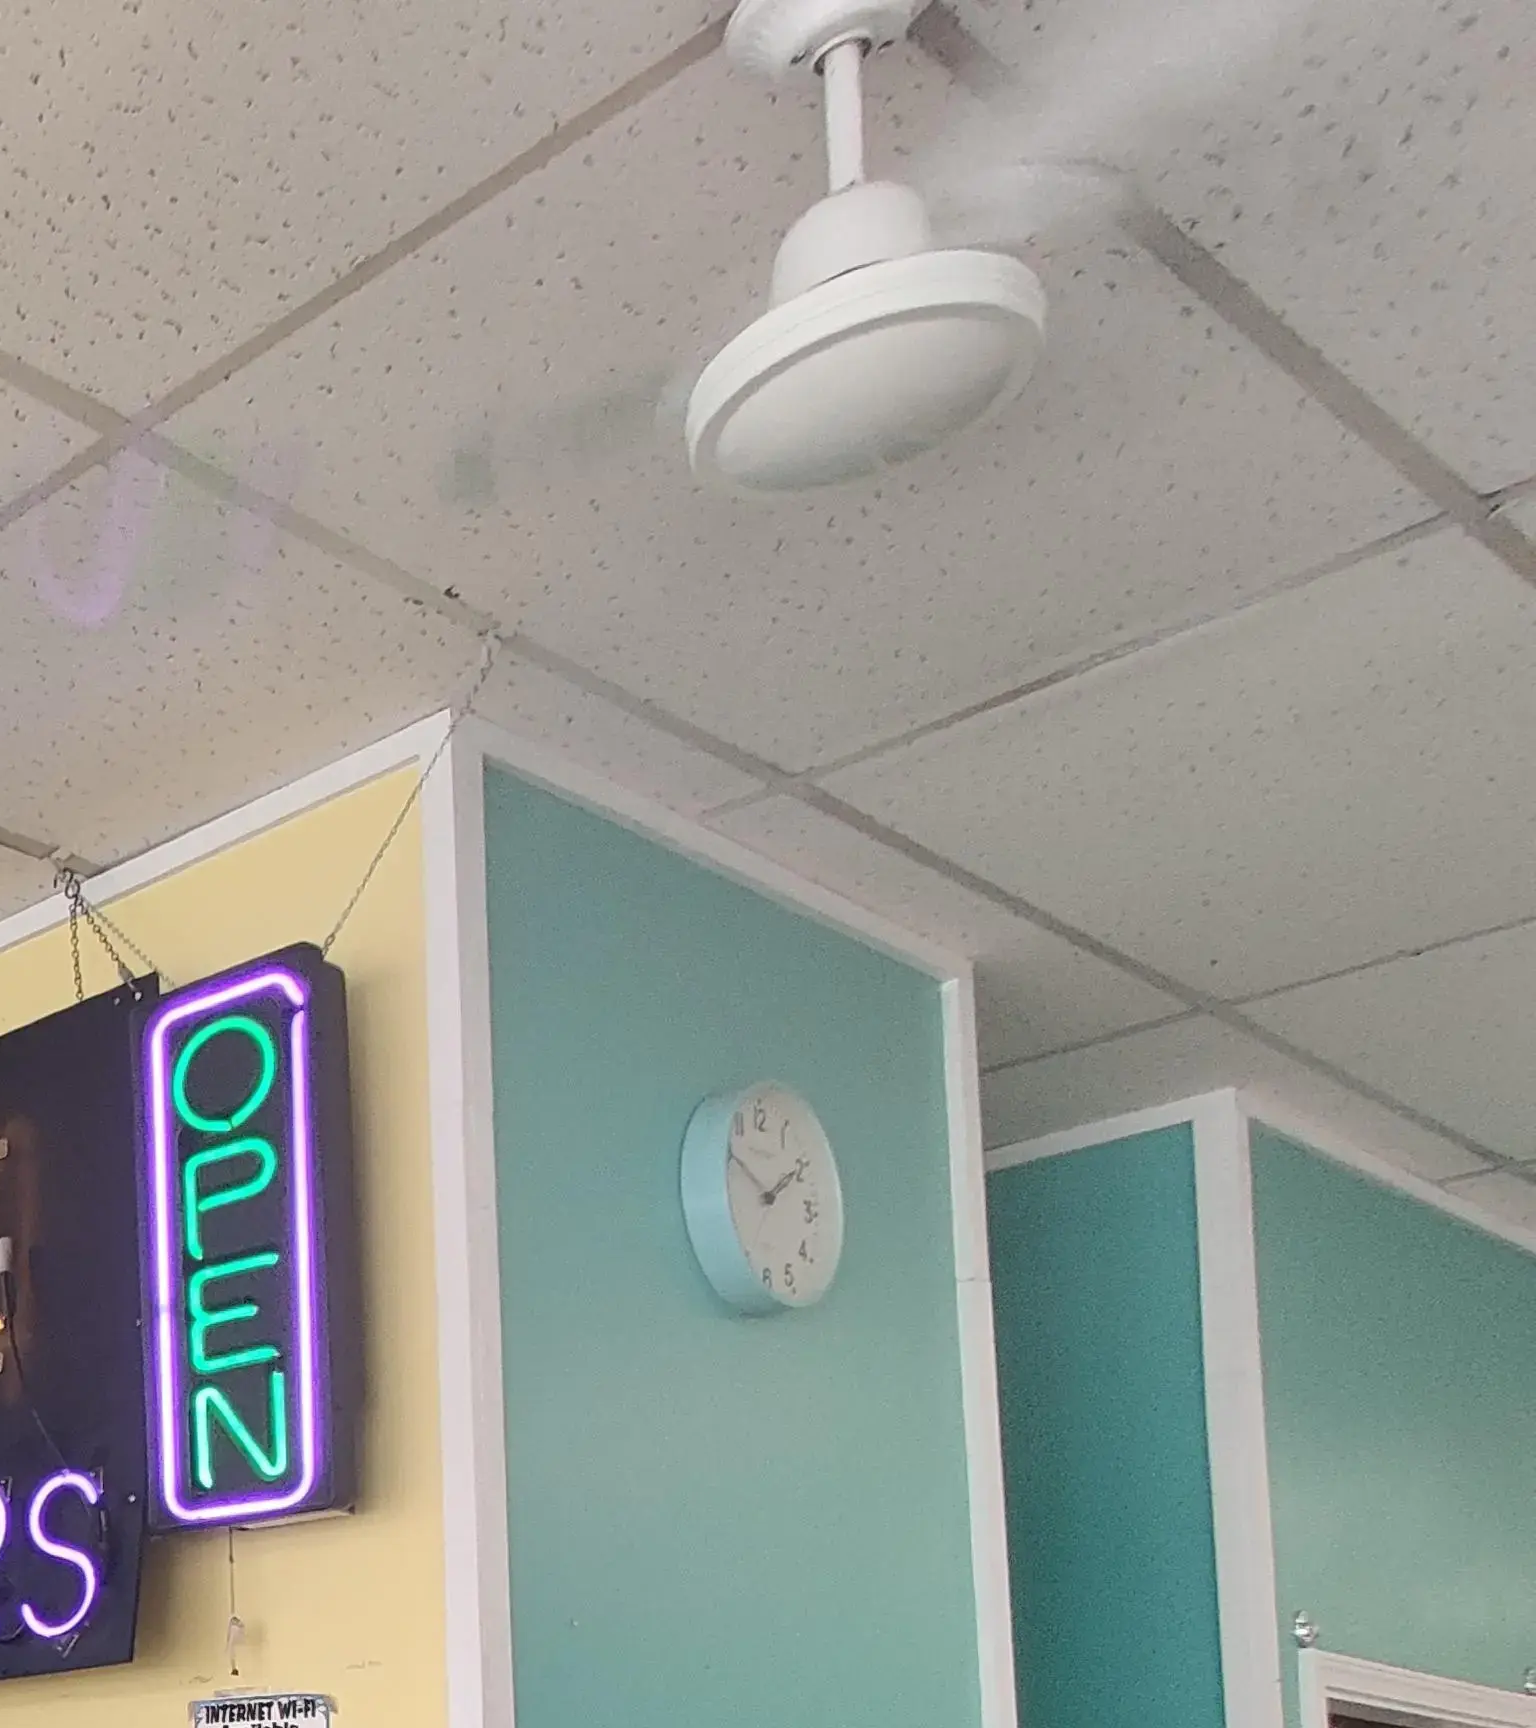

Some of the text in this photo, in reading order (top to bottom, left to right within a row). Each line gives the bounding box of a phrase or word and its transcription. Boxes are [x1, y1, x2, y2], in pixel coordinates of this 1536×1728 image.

[753, 1098, 766, 1132] 12
[173, 1016, 287, 1489] OPEN
[798, 1240, 808, 1261] 4
[784, 1263, 794, 1286] 5
[205, 1698, 317, 1724] INTERNET WI-FI
